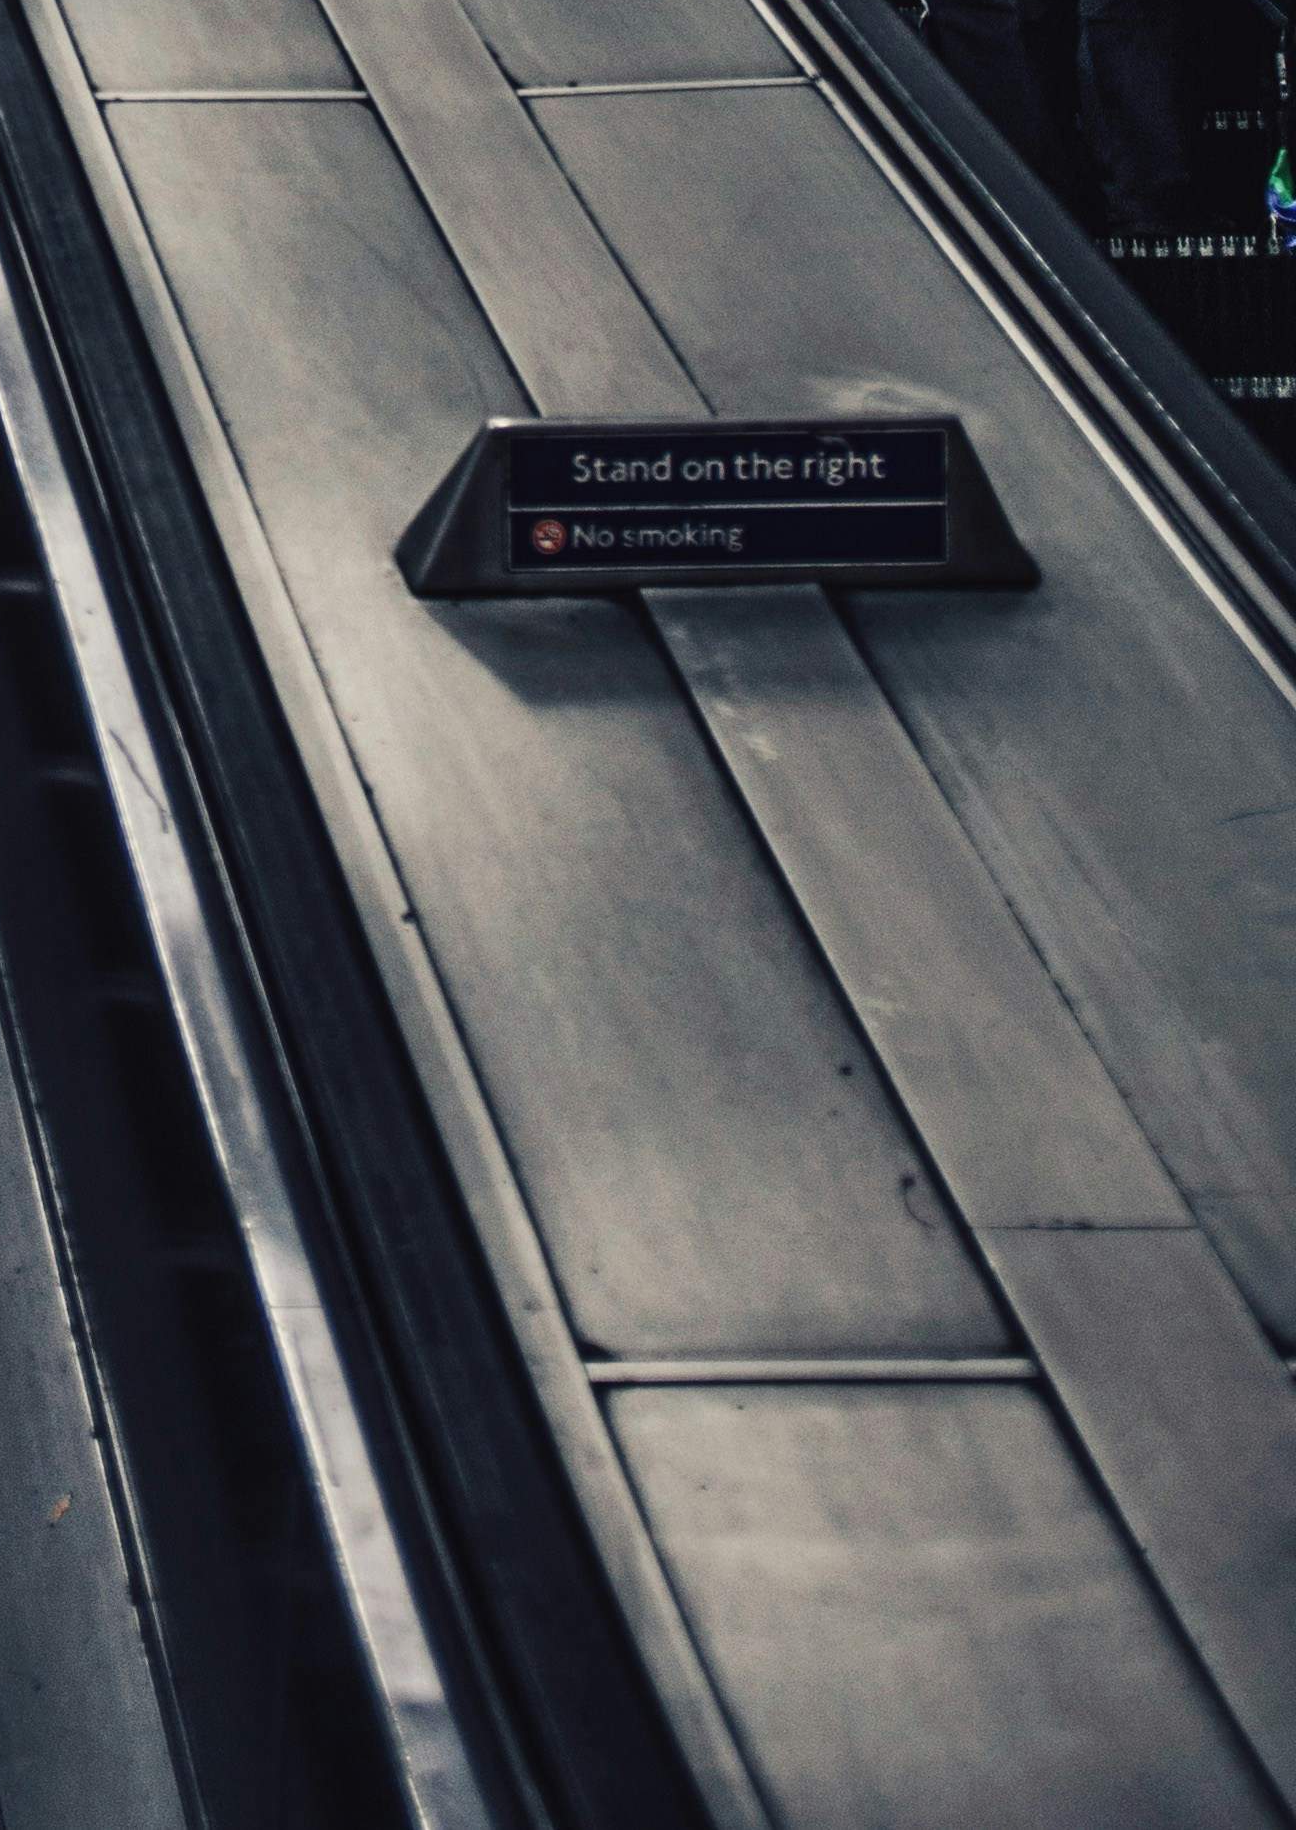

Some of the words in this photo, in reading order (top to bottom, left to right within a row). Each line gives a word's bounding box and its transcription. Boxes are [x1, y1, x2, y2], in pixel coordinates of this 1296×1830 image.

[573, 453, 672, 484] Stand
[682, 460, 726, 482] on
[734, 452, 794, 481] the
[804, 450, 887, 486] right
[573, 525, 615, 548] No
[622, 522, 743, 552] smoking
